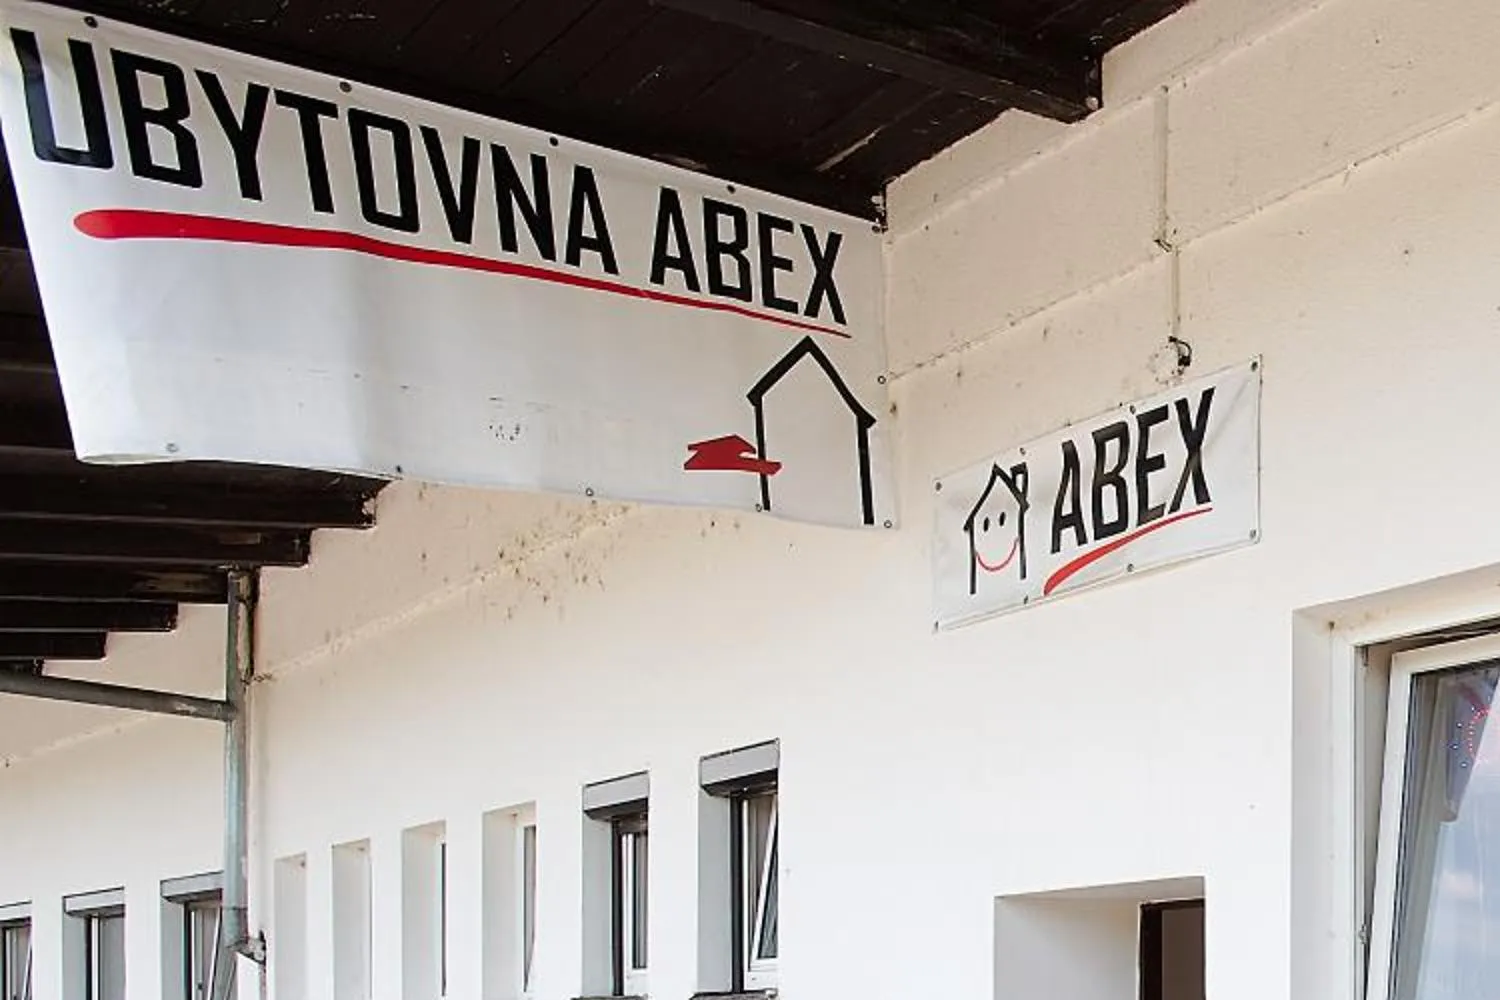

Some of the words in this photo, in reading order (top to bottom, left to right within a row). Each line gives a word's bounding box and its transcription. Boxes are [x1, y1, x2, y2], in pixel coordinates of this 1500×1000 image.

[11, 28, 619, 275] UBYTOVNA
[649, 186, 848, 325] ABEX
[1050, 386, 1216, 554] ABEX
